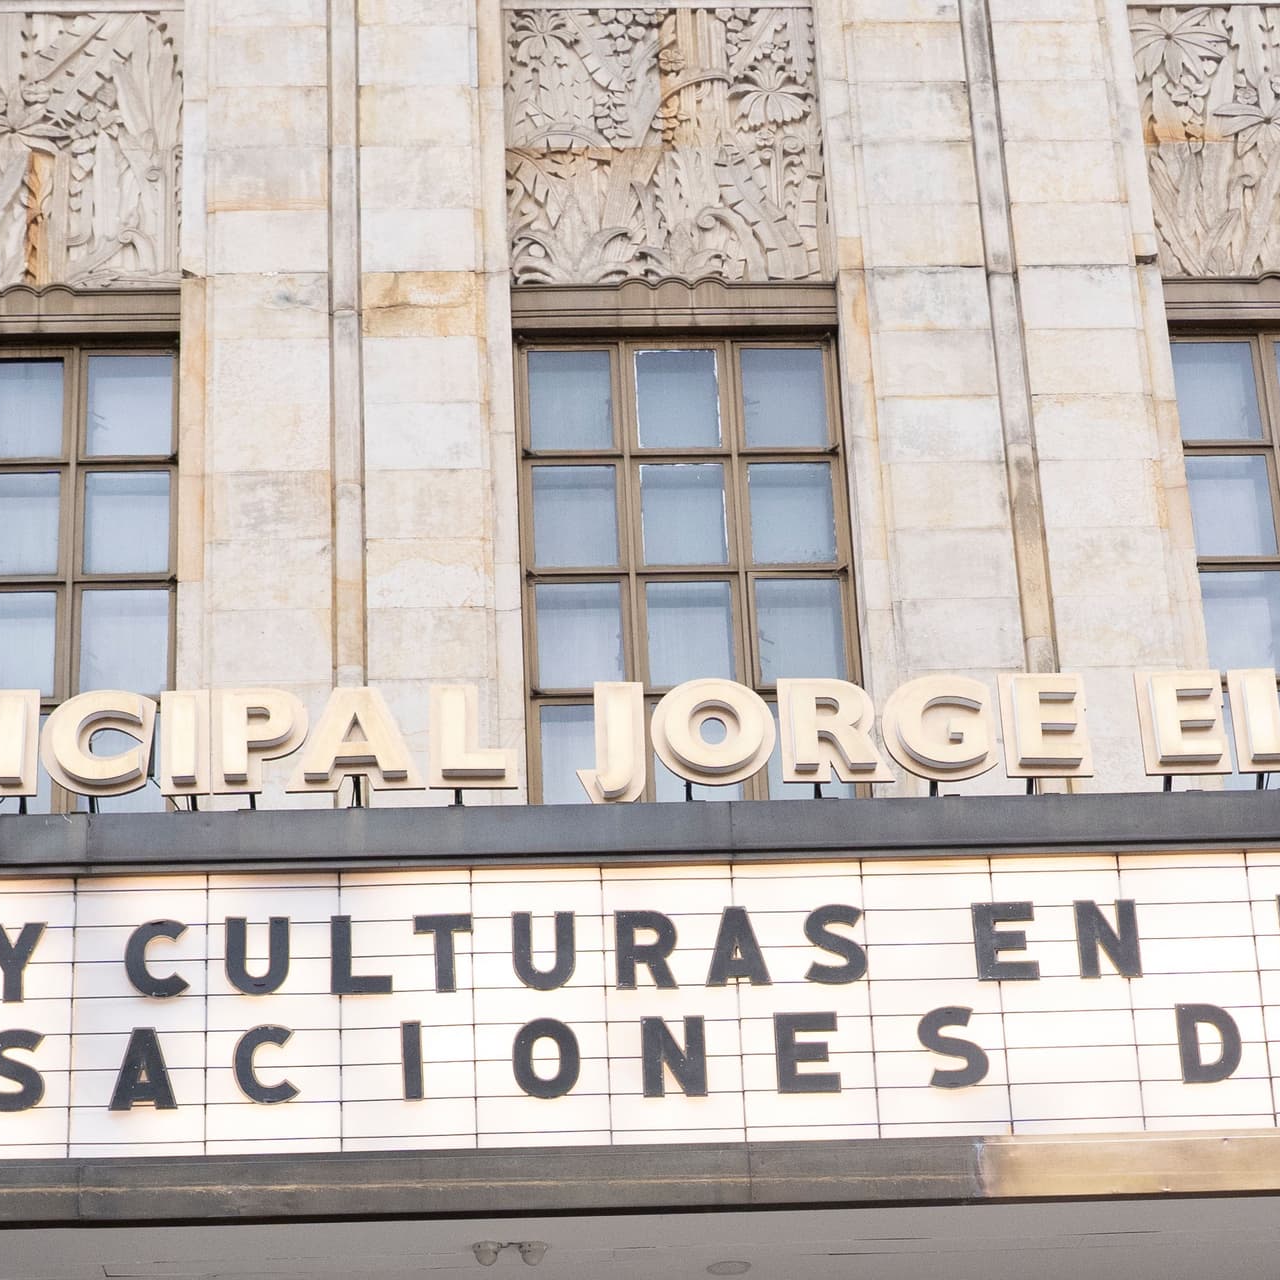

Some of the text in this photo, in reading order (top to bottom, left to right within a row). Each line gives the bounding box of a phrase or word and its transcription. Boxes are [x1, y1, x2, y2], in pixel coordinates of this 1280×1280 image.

[576, 672, 1095, 803] JORGE
[123, 903, 869, 999] CULTURAS
[970, 897, 1144, 982] EN
